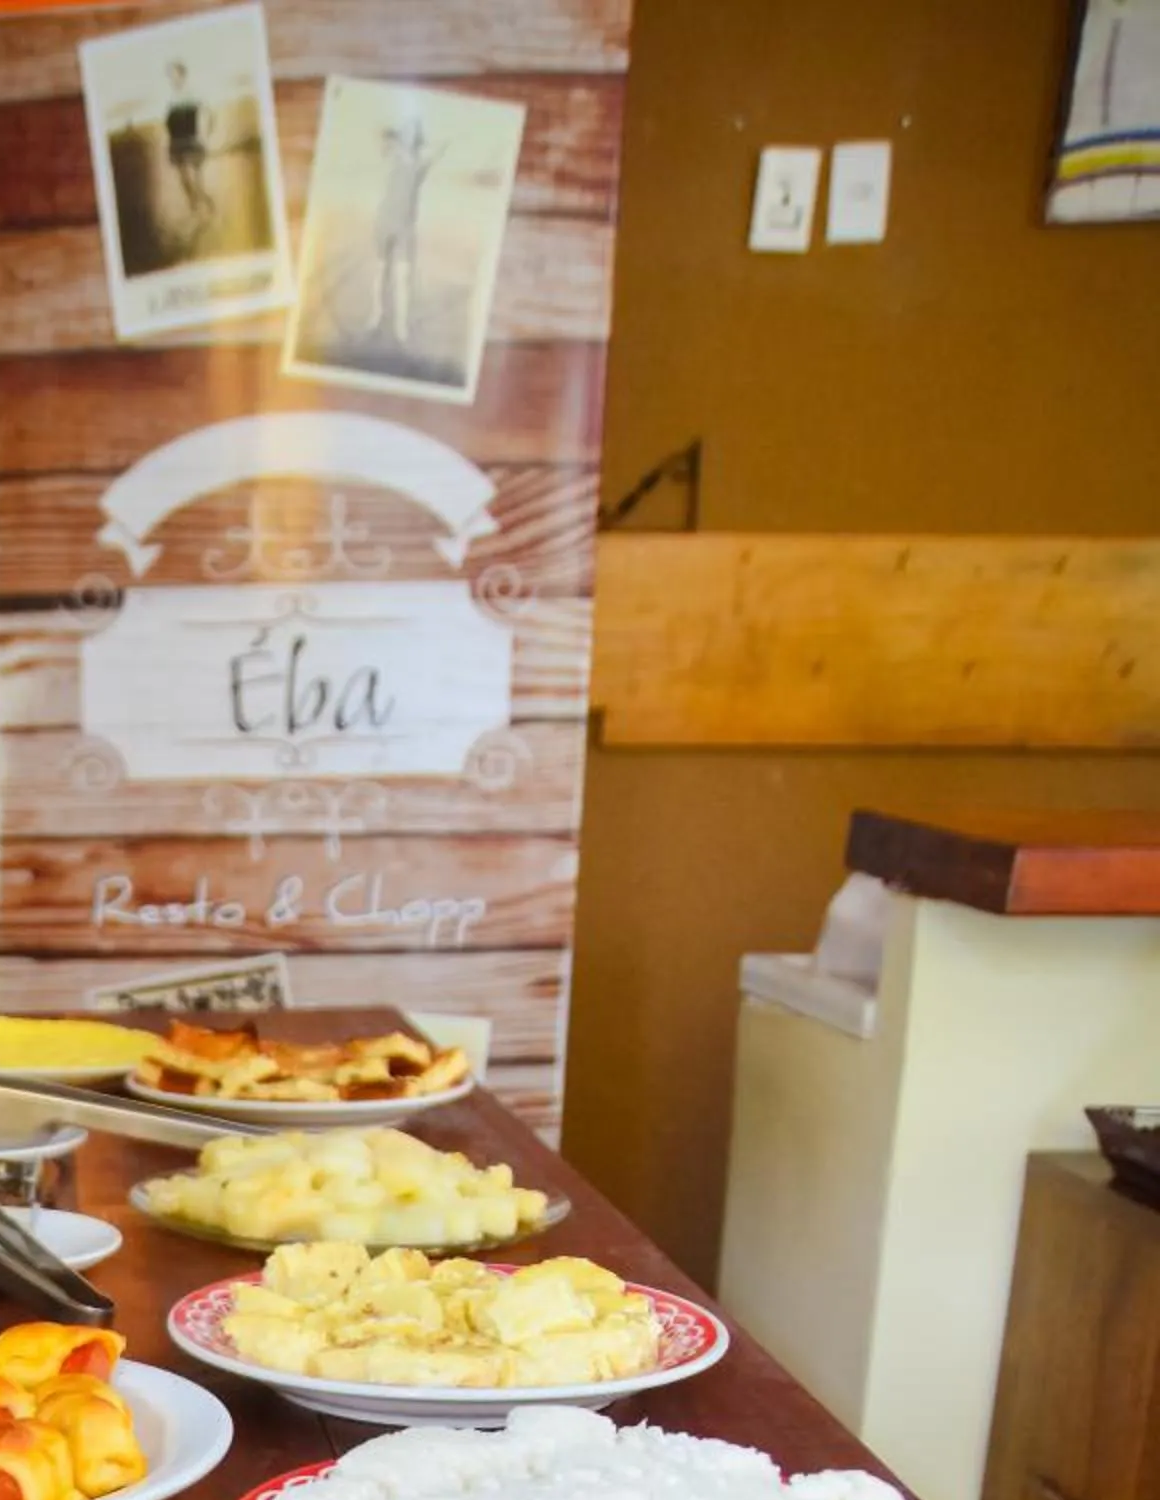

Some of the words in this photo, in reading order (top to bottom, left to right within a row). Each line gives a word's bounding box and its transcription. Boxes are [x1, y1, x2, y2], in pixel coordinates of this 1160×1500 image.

[229, 625, 398, 735] Éba
[91, 874, 246, 929] Resto
[266, 874, 305, 927] &
[325, 871, 487, 946] Chopp
